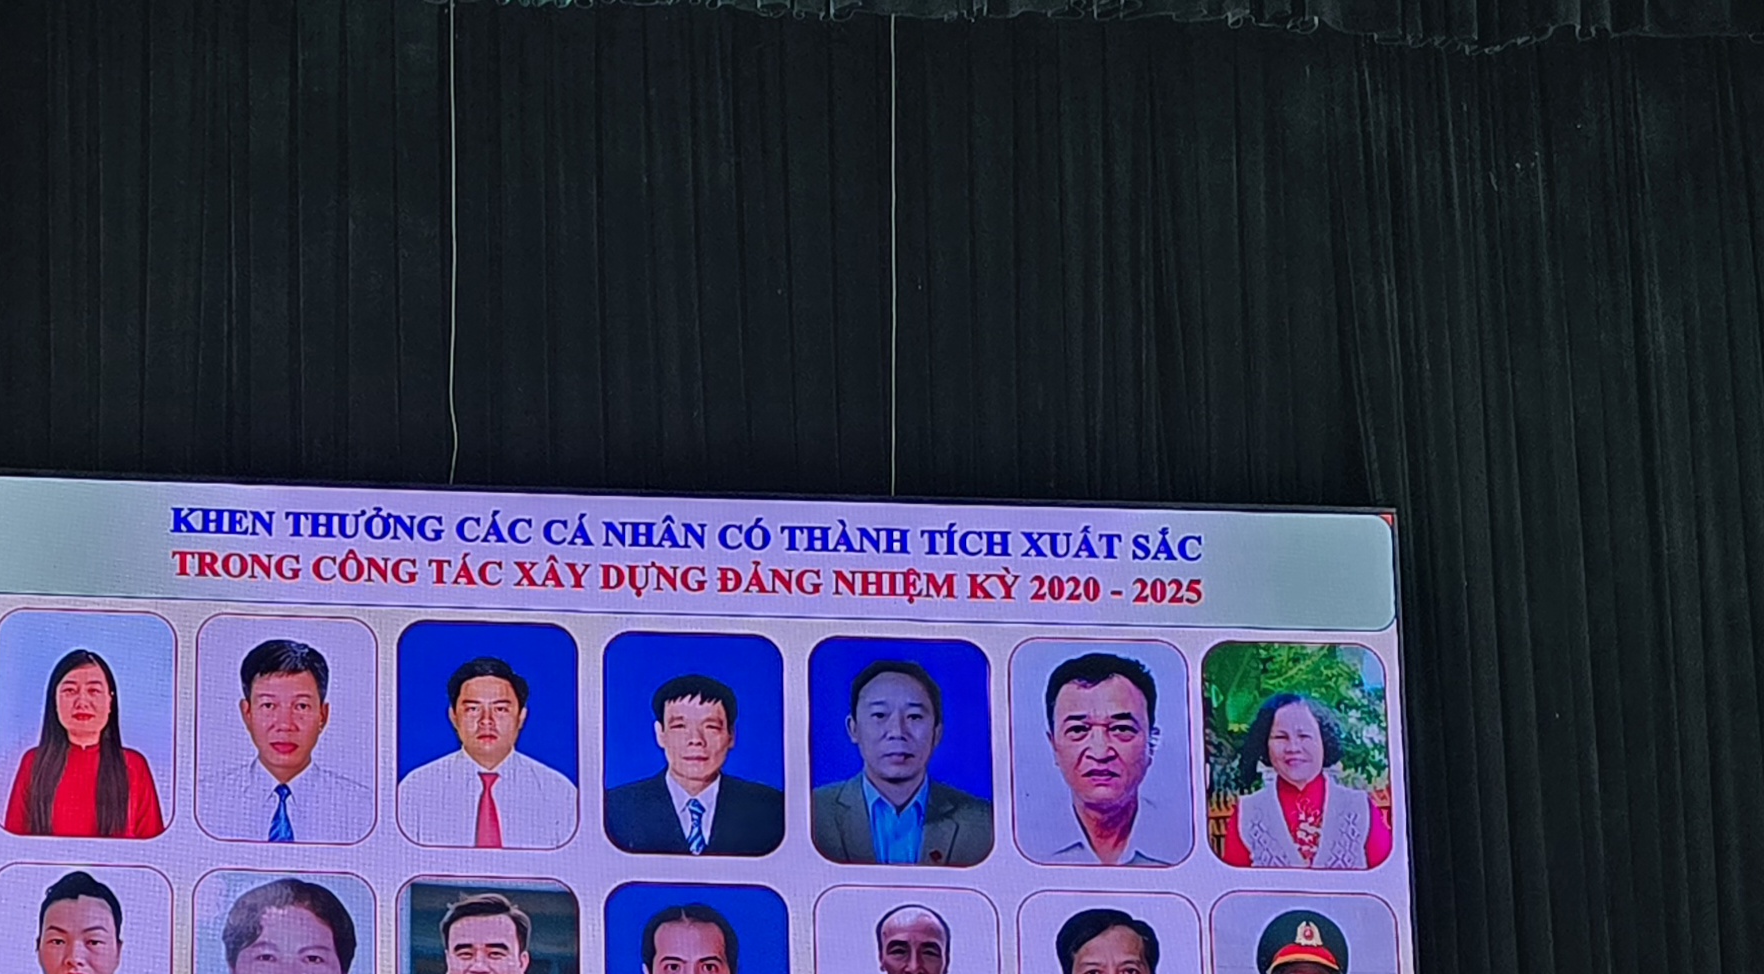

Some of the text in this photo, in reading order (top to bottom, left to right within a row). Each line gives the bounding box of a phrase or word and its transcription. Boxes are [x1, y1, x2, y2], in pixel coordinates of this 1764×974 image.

[170, 506, 1203, 562] KHEN THƯỞNG CÁC CÁ NHÂN CÓ THÀNH TÍCH XUẤT SẮC
[172, 551, 301, 581] TRONG
[312, 551, 418, 585] CÔNG
[428, 554, 503, 587] TÁC
[514, 555, 590, 590] XÂY
[600, 561, 706, 597] DỰNG
[717, 561, 822, 595] ĐẢNG
[833, 569, 956, 603] NHIỆM
[967, 567, 1020, 600] KỲ
[1030, 576, 1102, 603] 2020
[1132, 579, 1203, 605] 2025
